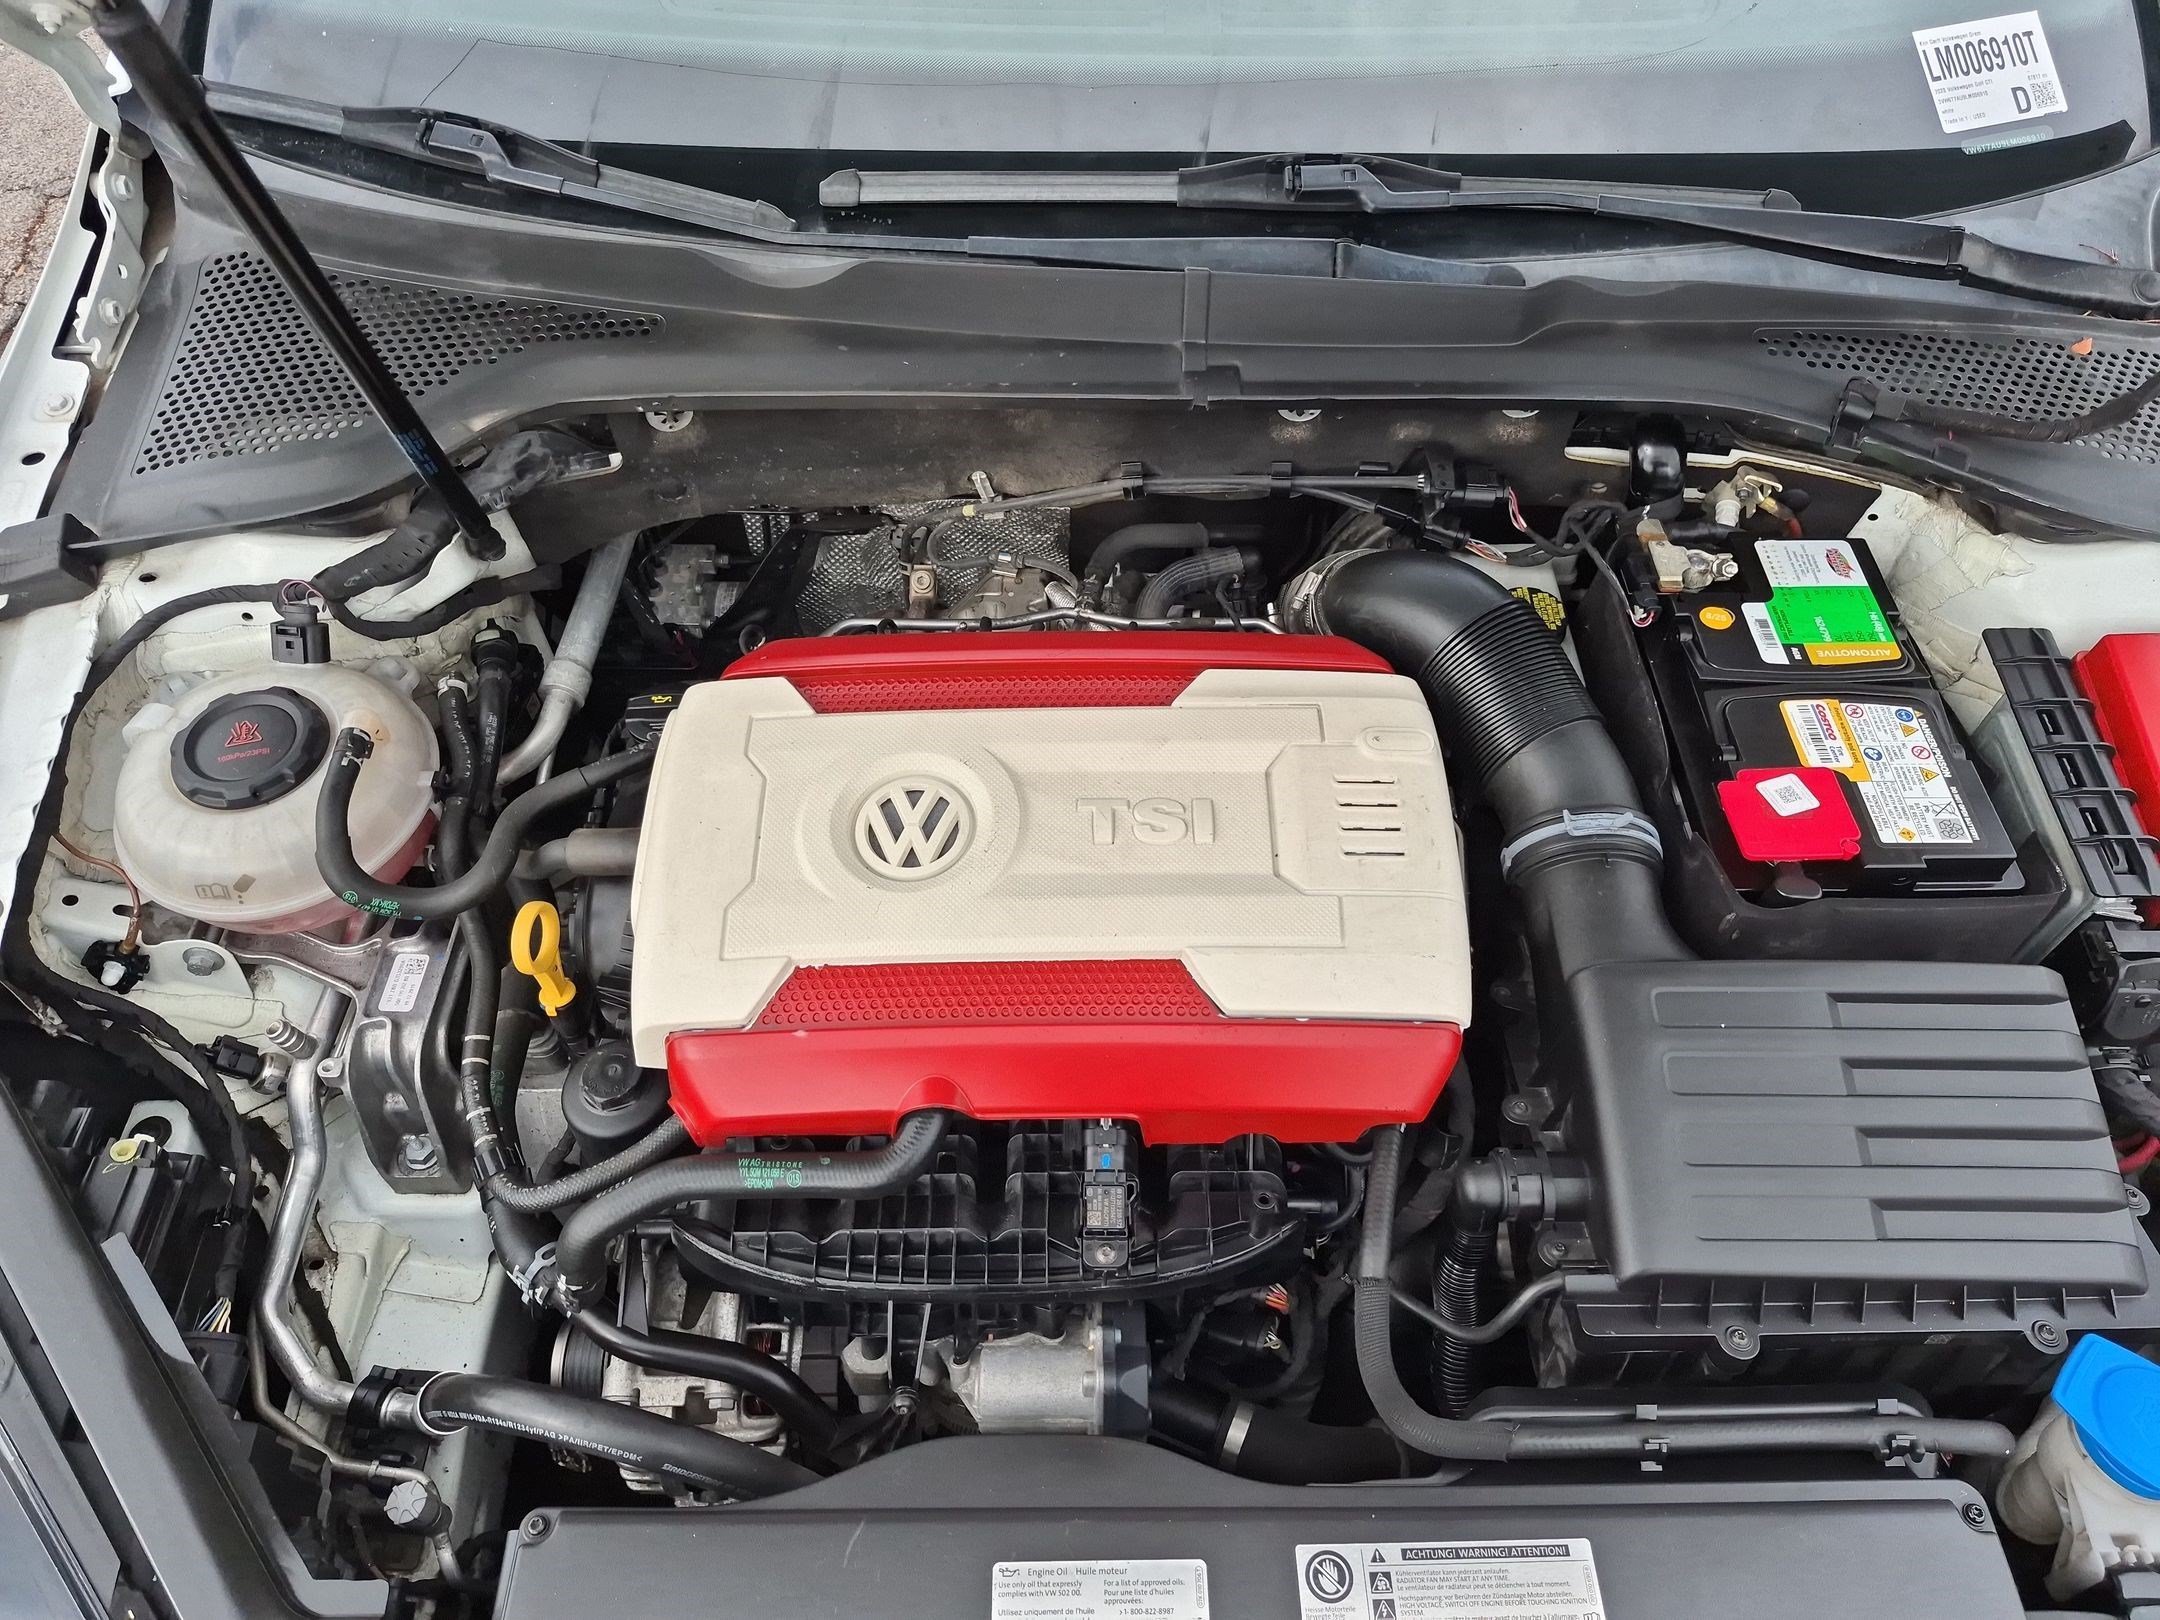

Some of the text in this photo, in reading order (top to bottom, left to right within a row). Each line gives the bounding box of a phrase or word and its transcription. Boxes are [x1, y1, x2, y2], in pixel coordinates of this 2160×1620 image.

[1921, 30, 2039, 83] LM006910T
[2011, 86, 2032, 114] D
[1790, 647, 1803, 660] AGM
[1816, 649, 1891, 657] AUTOMOTIVE
[1816, 703, 1837, 741] COSTCO
[1834, 707, 1842, 722] Return
[1851, 751, 1860, 764] used
[1835, 746, 1844, 757] Tire
[1918, 718, 1952, 778] DANGER/POISON
[1829, 745, 1840, 763] Center
[1871, 794, 1890, 830] NONSPILLABLE
[1923, 804, 1930, 814] Pb
[1076, 797, 1216, 846] TSI
[1913, 802, 1935, 838] BATTERY MUST
[738, 1158, 802, 1169] VW AG TRISTONE
[780, 1168, 785, 1178] E
[1405, 1545, 1566, 1560] ACHTUNG! WARNING! ATTENTION!
[1027, 1567, 1128, 1578] Engine Oil Huile moteur
[1458, 1568, 1483, 1577] jederzeit
[998, 1580, 1082, 1590] Use only oil that expressly
[1103, 1579, 1114, 1587] For
[1120, 1579, 1131, 1587] list
[1132, 1579, 1139, 1587] of
[1140, 1578, 1171, 1588] approved
[1403, 1583, 1437, 1591] ventilateur
[1473, 1583, 1486, 1591] peut
[998, 1590, 1027, 1599] complies
[1028, 1589, 1043, 1597] with
[1045, 1589, 1056, 1597] VW
[1058, 1589, 1070, 1597] 502
[1134, 1588, 1148, 1596] liste
[1149, 1588, 1175, 1596] d'huiles
[1492, 1592, 1527, 1601] Zündanlage
[1103, 1597, 1144, 1606] approuvées:
[1400, 1602, 1416, 1610] HIGH
[1445, 1600, 1468, 1608] SWITCH
[1480, 1599, 1502, 1607] ENGINE
[1528, 1598, 1560, 1606] TOUCHING
[1560, 1597, 1588, 1605] IGNITION
[997, 1609, 1022, 1617] Utilisez
[1023, 1608, 1064, 1617] uniquement
[1064, 1608, 1074, 1616] de
